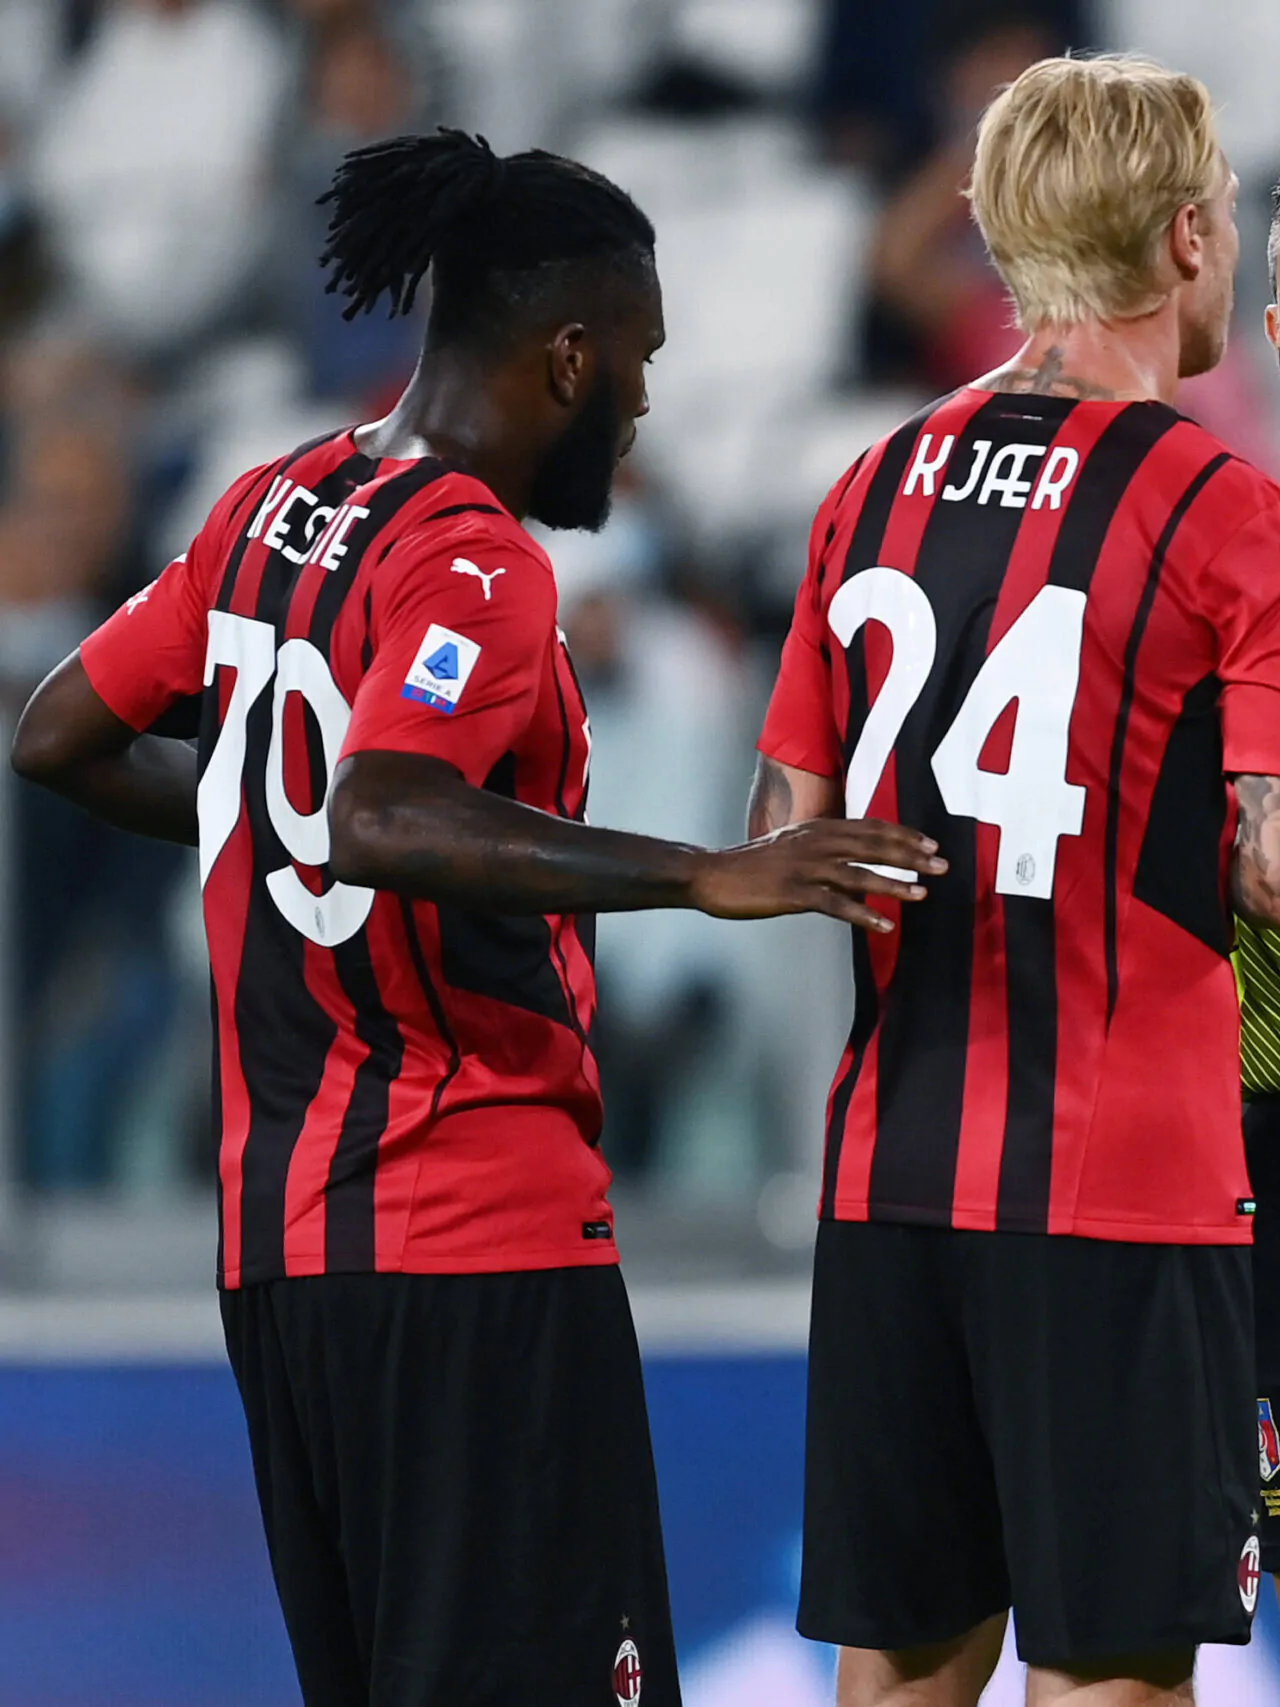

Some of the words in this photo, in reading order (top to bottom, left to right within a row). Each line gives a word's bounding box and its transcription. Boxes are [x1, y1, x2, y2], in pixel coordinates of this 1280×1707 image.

[903, 434, 1079, 510] KJÆR
[197, 609, 376, 947] 79
[828, 566, 1087, 899] 24
